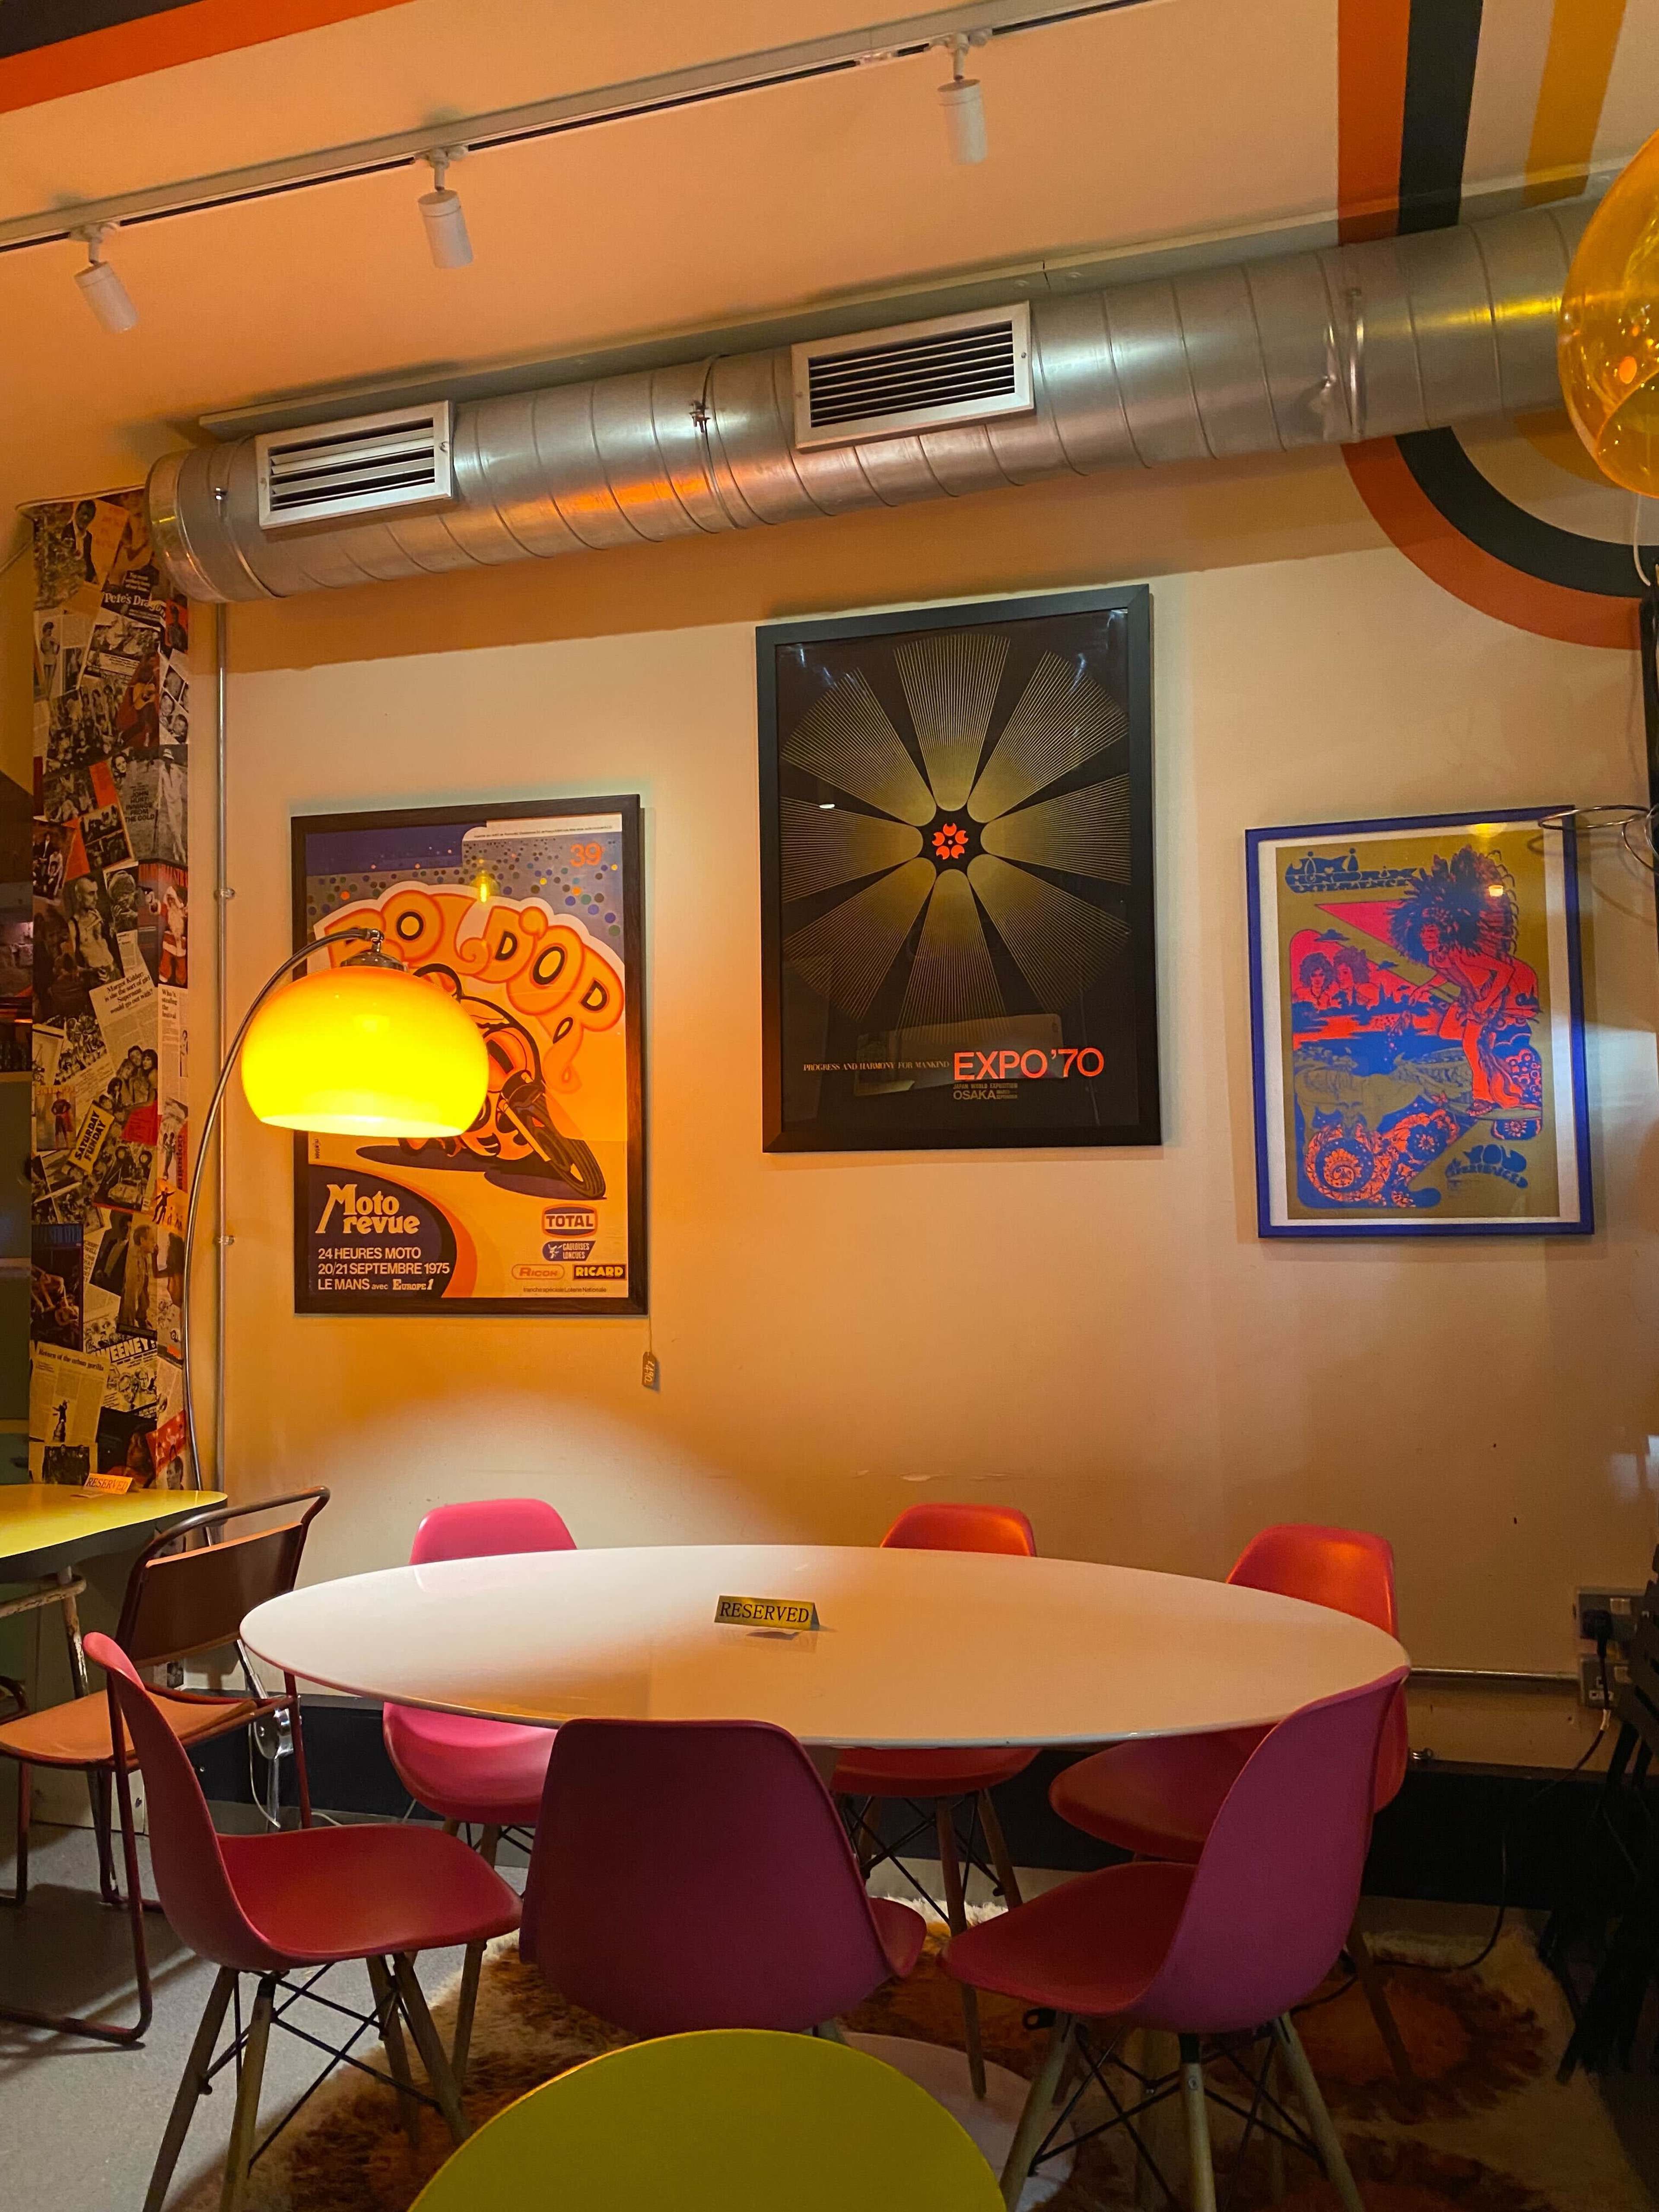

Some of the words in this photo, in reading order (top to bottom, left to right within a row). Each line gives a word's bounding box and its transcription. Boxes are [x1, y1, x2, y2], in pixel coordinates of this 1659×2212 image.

[104, 593, 132, 604] Pete's
[860, 1062, 895, 1070] HARMONY
[915, 1060, 950, 1068] MANKIND
[953, 1090, 996, 1100] OSAKA
[74, 1110, 100, 1161] SATURDAY
[84, 1119, 106, 1161] FUNDAY
[315, 1184, 400, 1233] Moto
[343, 1215, 420, 1234] revue
[546, 1215, 594, 1227] TOTAL
[318, 1248, 333, 1259] 24
[334, 1247, 382, 1259] HEURES
[385, 1247, 421, 1259] MOTO
[563, 1243, 590, 1251] GAULOISES
[318, 1262, 347, 1275] 20/21
[349, 1262, 422, 1274] SEPTEMBRE
[424, 1263, 450, 1274] 1975
[575, 1266, 624, 1278] RICARD
[318, 1278, 332, 1290] LE
[334, 1278, 370, 1290] MANS
[86, 1478, 128, 1491] RESERVED
[720, 1602, 809, 1623] RESERVED
